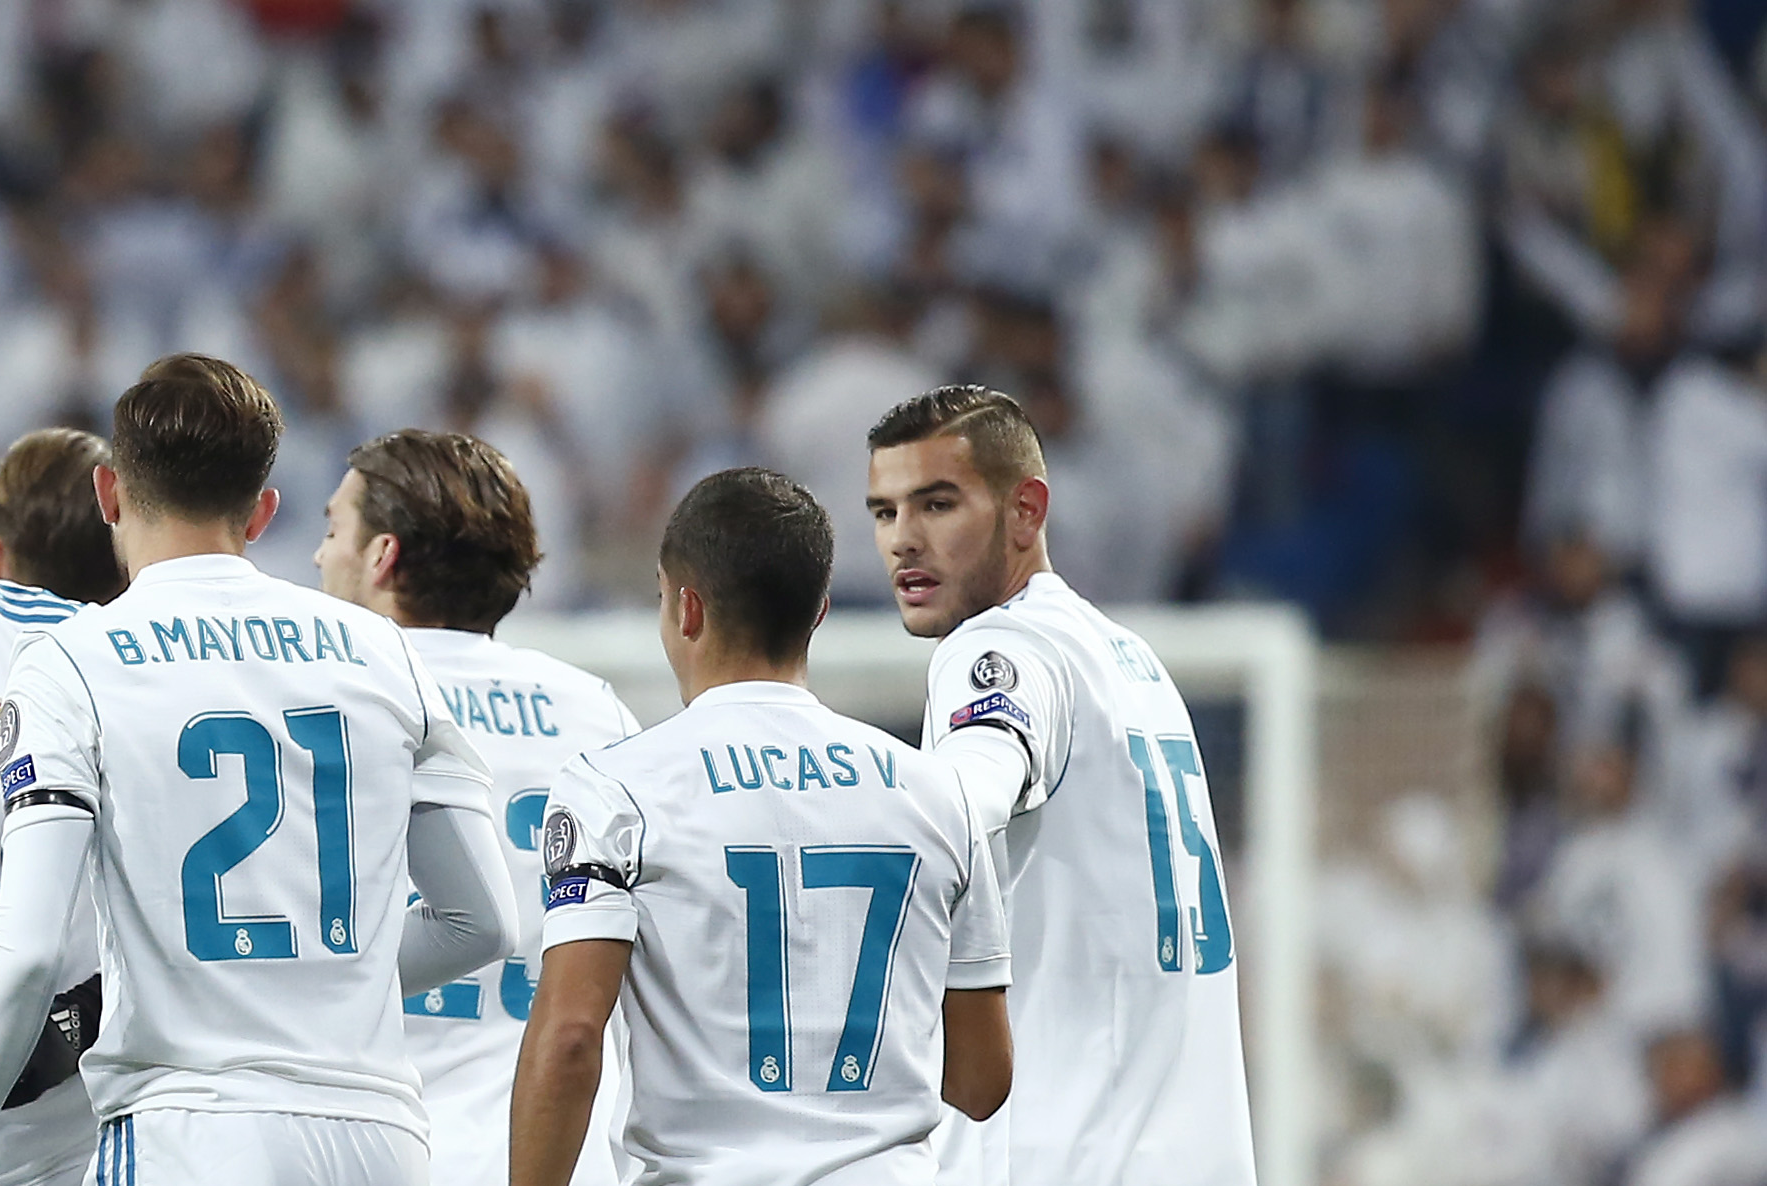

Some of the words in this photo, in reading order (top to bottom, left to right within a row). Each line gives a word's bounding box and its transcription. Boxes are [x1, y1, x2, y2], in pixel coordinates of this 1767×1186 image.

[106, 615, 367, 667] B.MAYORAL
[177, 705, 359, 962] 21
[700, 743, 860, 794] LUCAS
[865, 743, 908, 791] V.
[1125, 727, 1234, 975] 15
[724, 845, 922, 1092] 17
